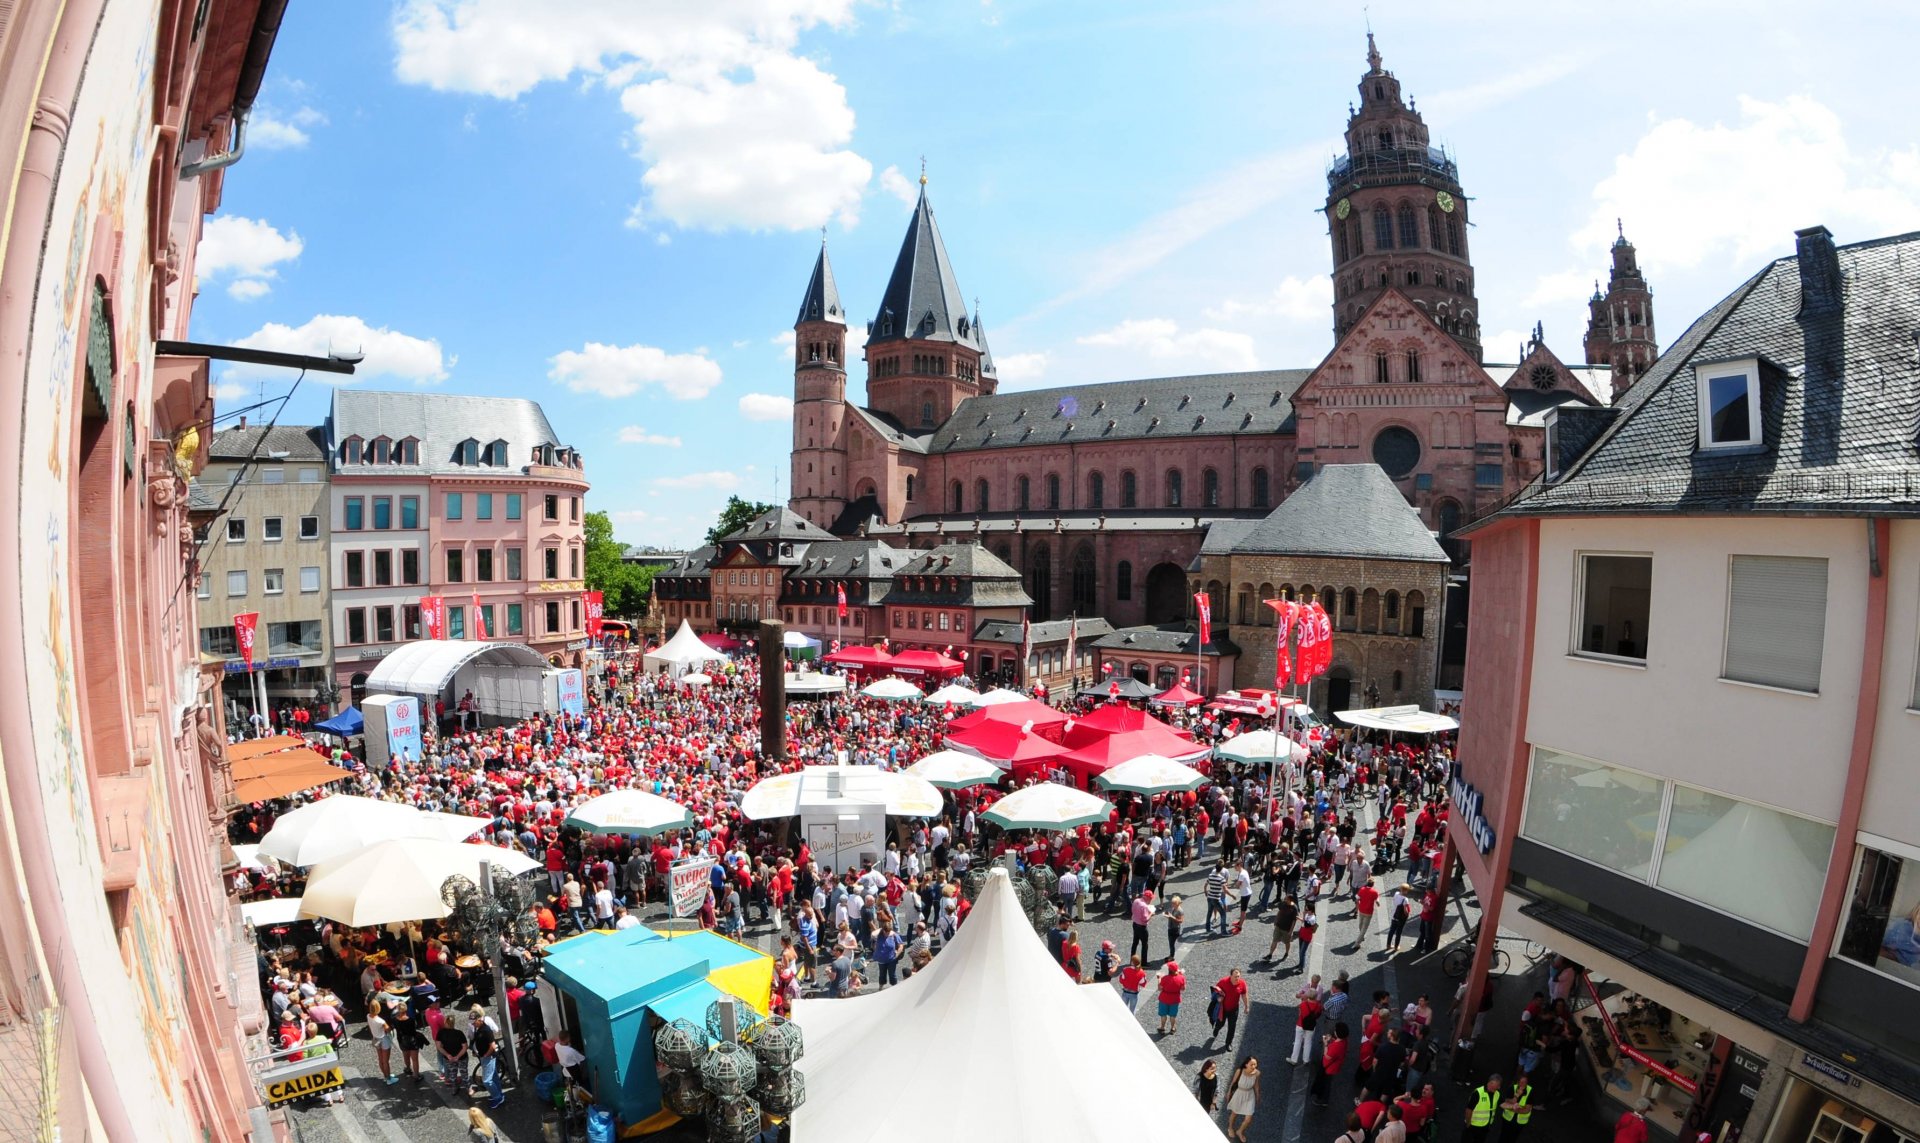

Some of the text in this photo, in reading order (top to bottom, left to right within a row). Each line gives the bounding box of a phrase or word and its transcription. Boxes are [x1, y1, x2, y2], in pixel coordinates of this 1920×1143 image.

[812, 840, 834, 852] Bitte
[855, 831, 874, 843] Bit
[269, 1070, 339, 1099] CALIDA
[273, 1085, 342, 1108] BODYWEAR
